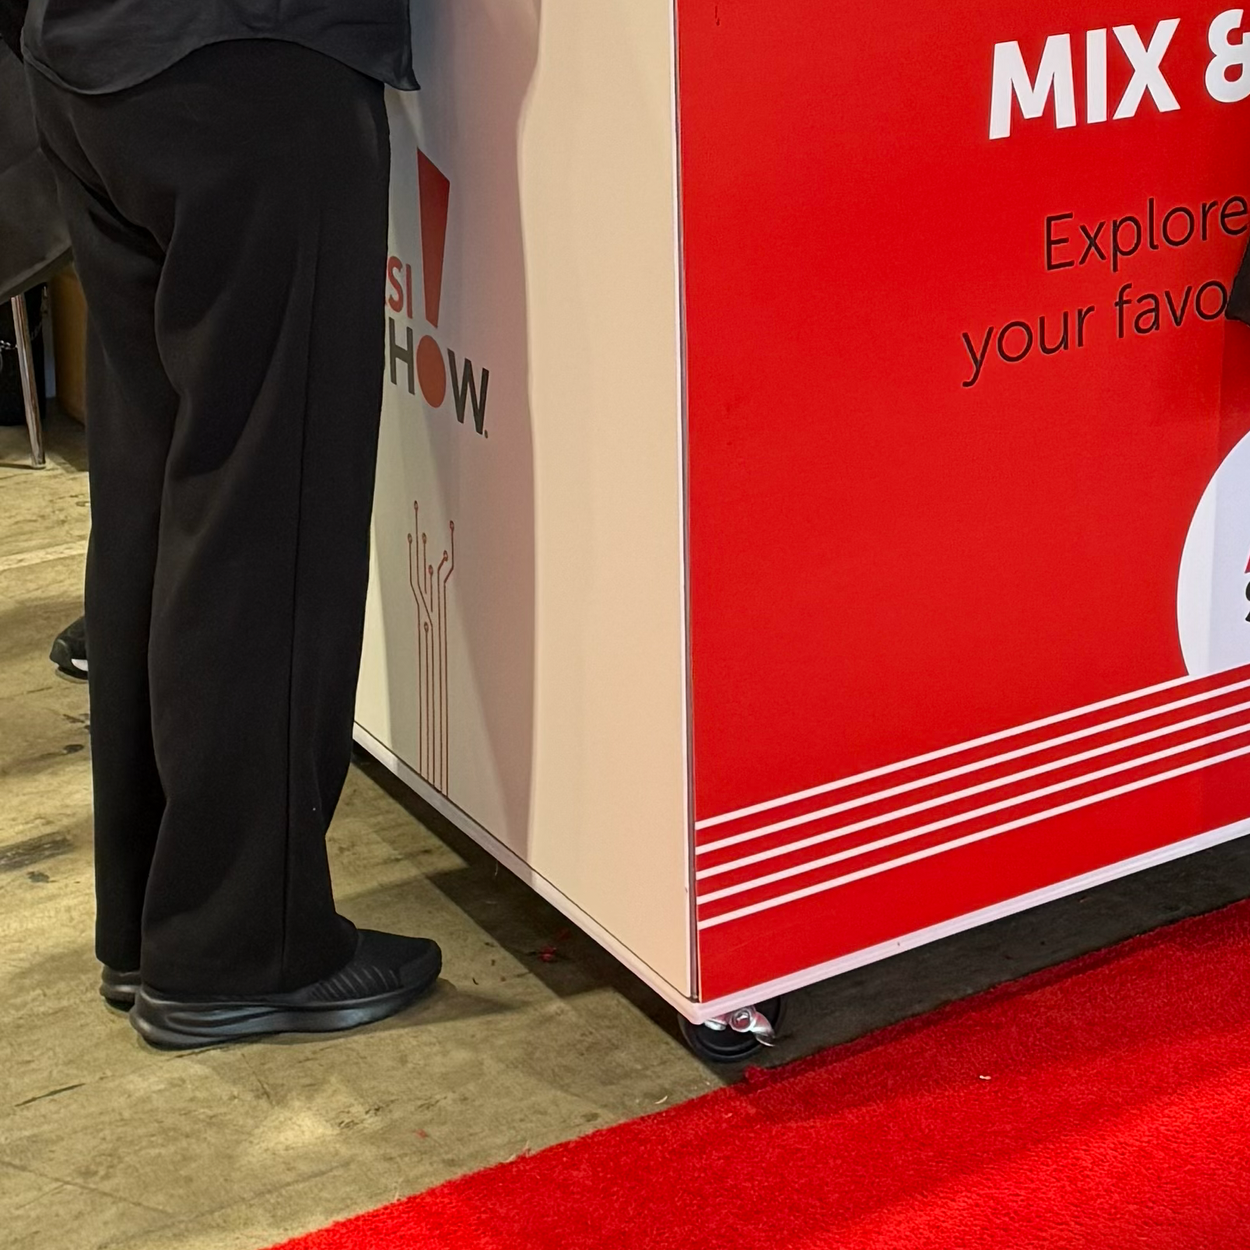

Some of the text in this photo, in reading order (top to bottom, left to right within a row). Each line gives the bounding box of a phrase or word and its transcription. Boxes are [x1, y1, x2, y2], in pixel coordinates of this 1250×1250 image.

[989, 18, 1180, 140] MIX
[385, 255, 413, 320] SI
[1045, 196, 1249, 272] Explore
[389, 316, 489, 439] HOW
[961, 280, 1229, 388] your favo
